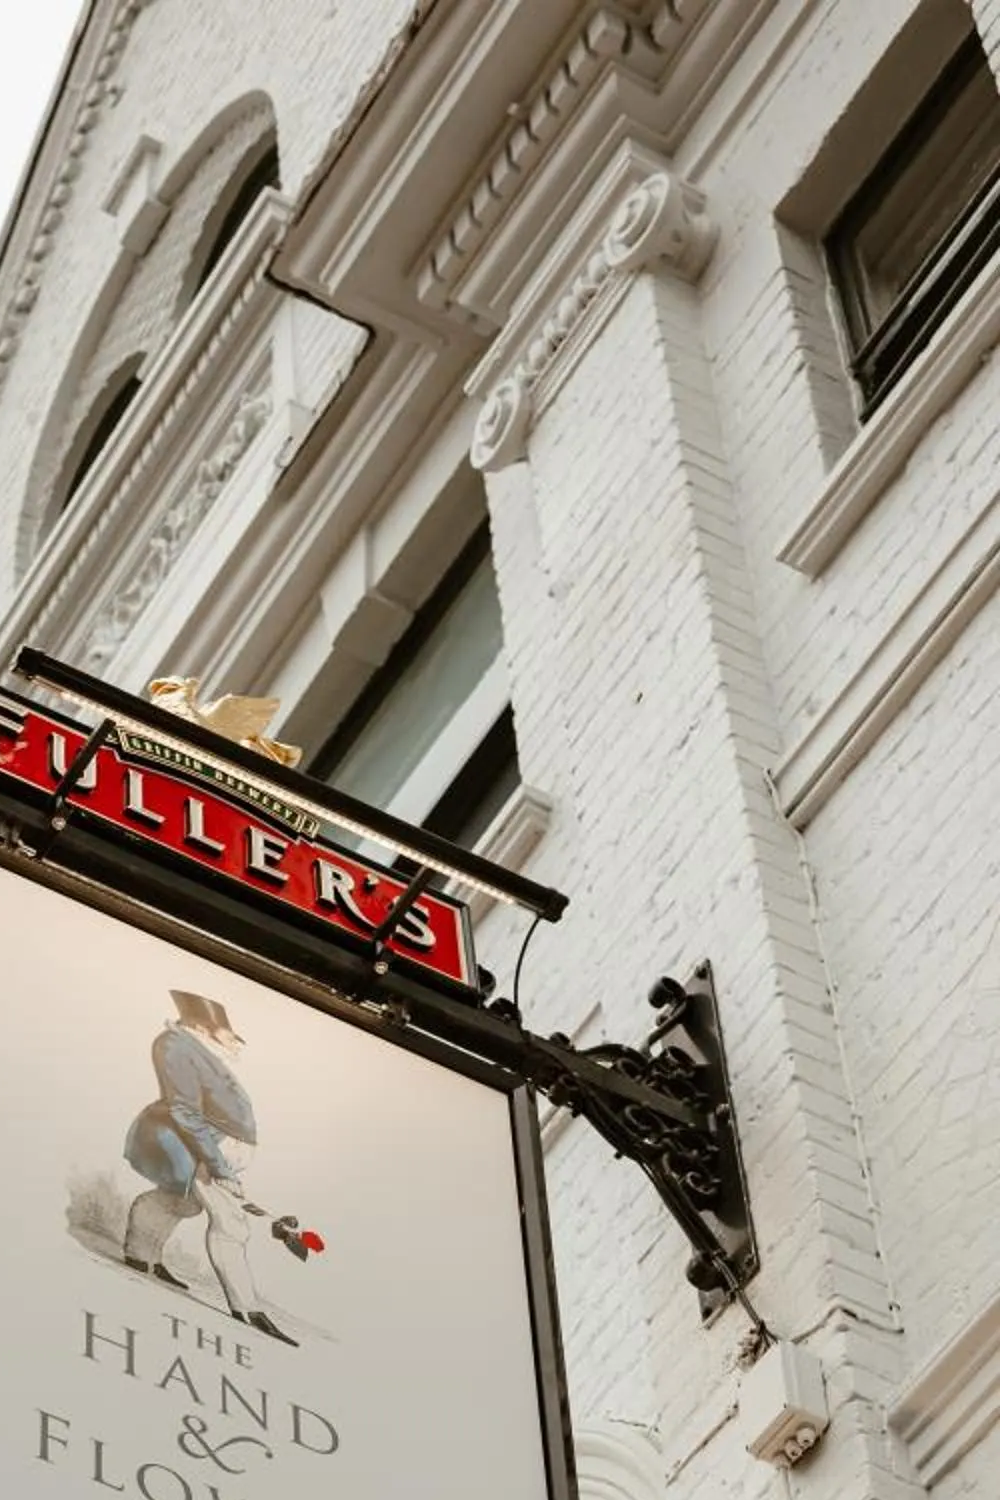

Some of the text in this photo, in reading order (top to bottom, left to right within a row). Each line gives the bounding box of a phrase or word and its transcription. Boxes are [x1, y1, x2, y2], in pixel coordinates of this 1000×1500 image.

[161, 1313, 254, 1370] THE
[80, 1309, 340, 1456] HAND
[176, 1413, 274, 1475] &
